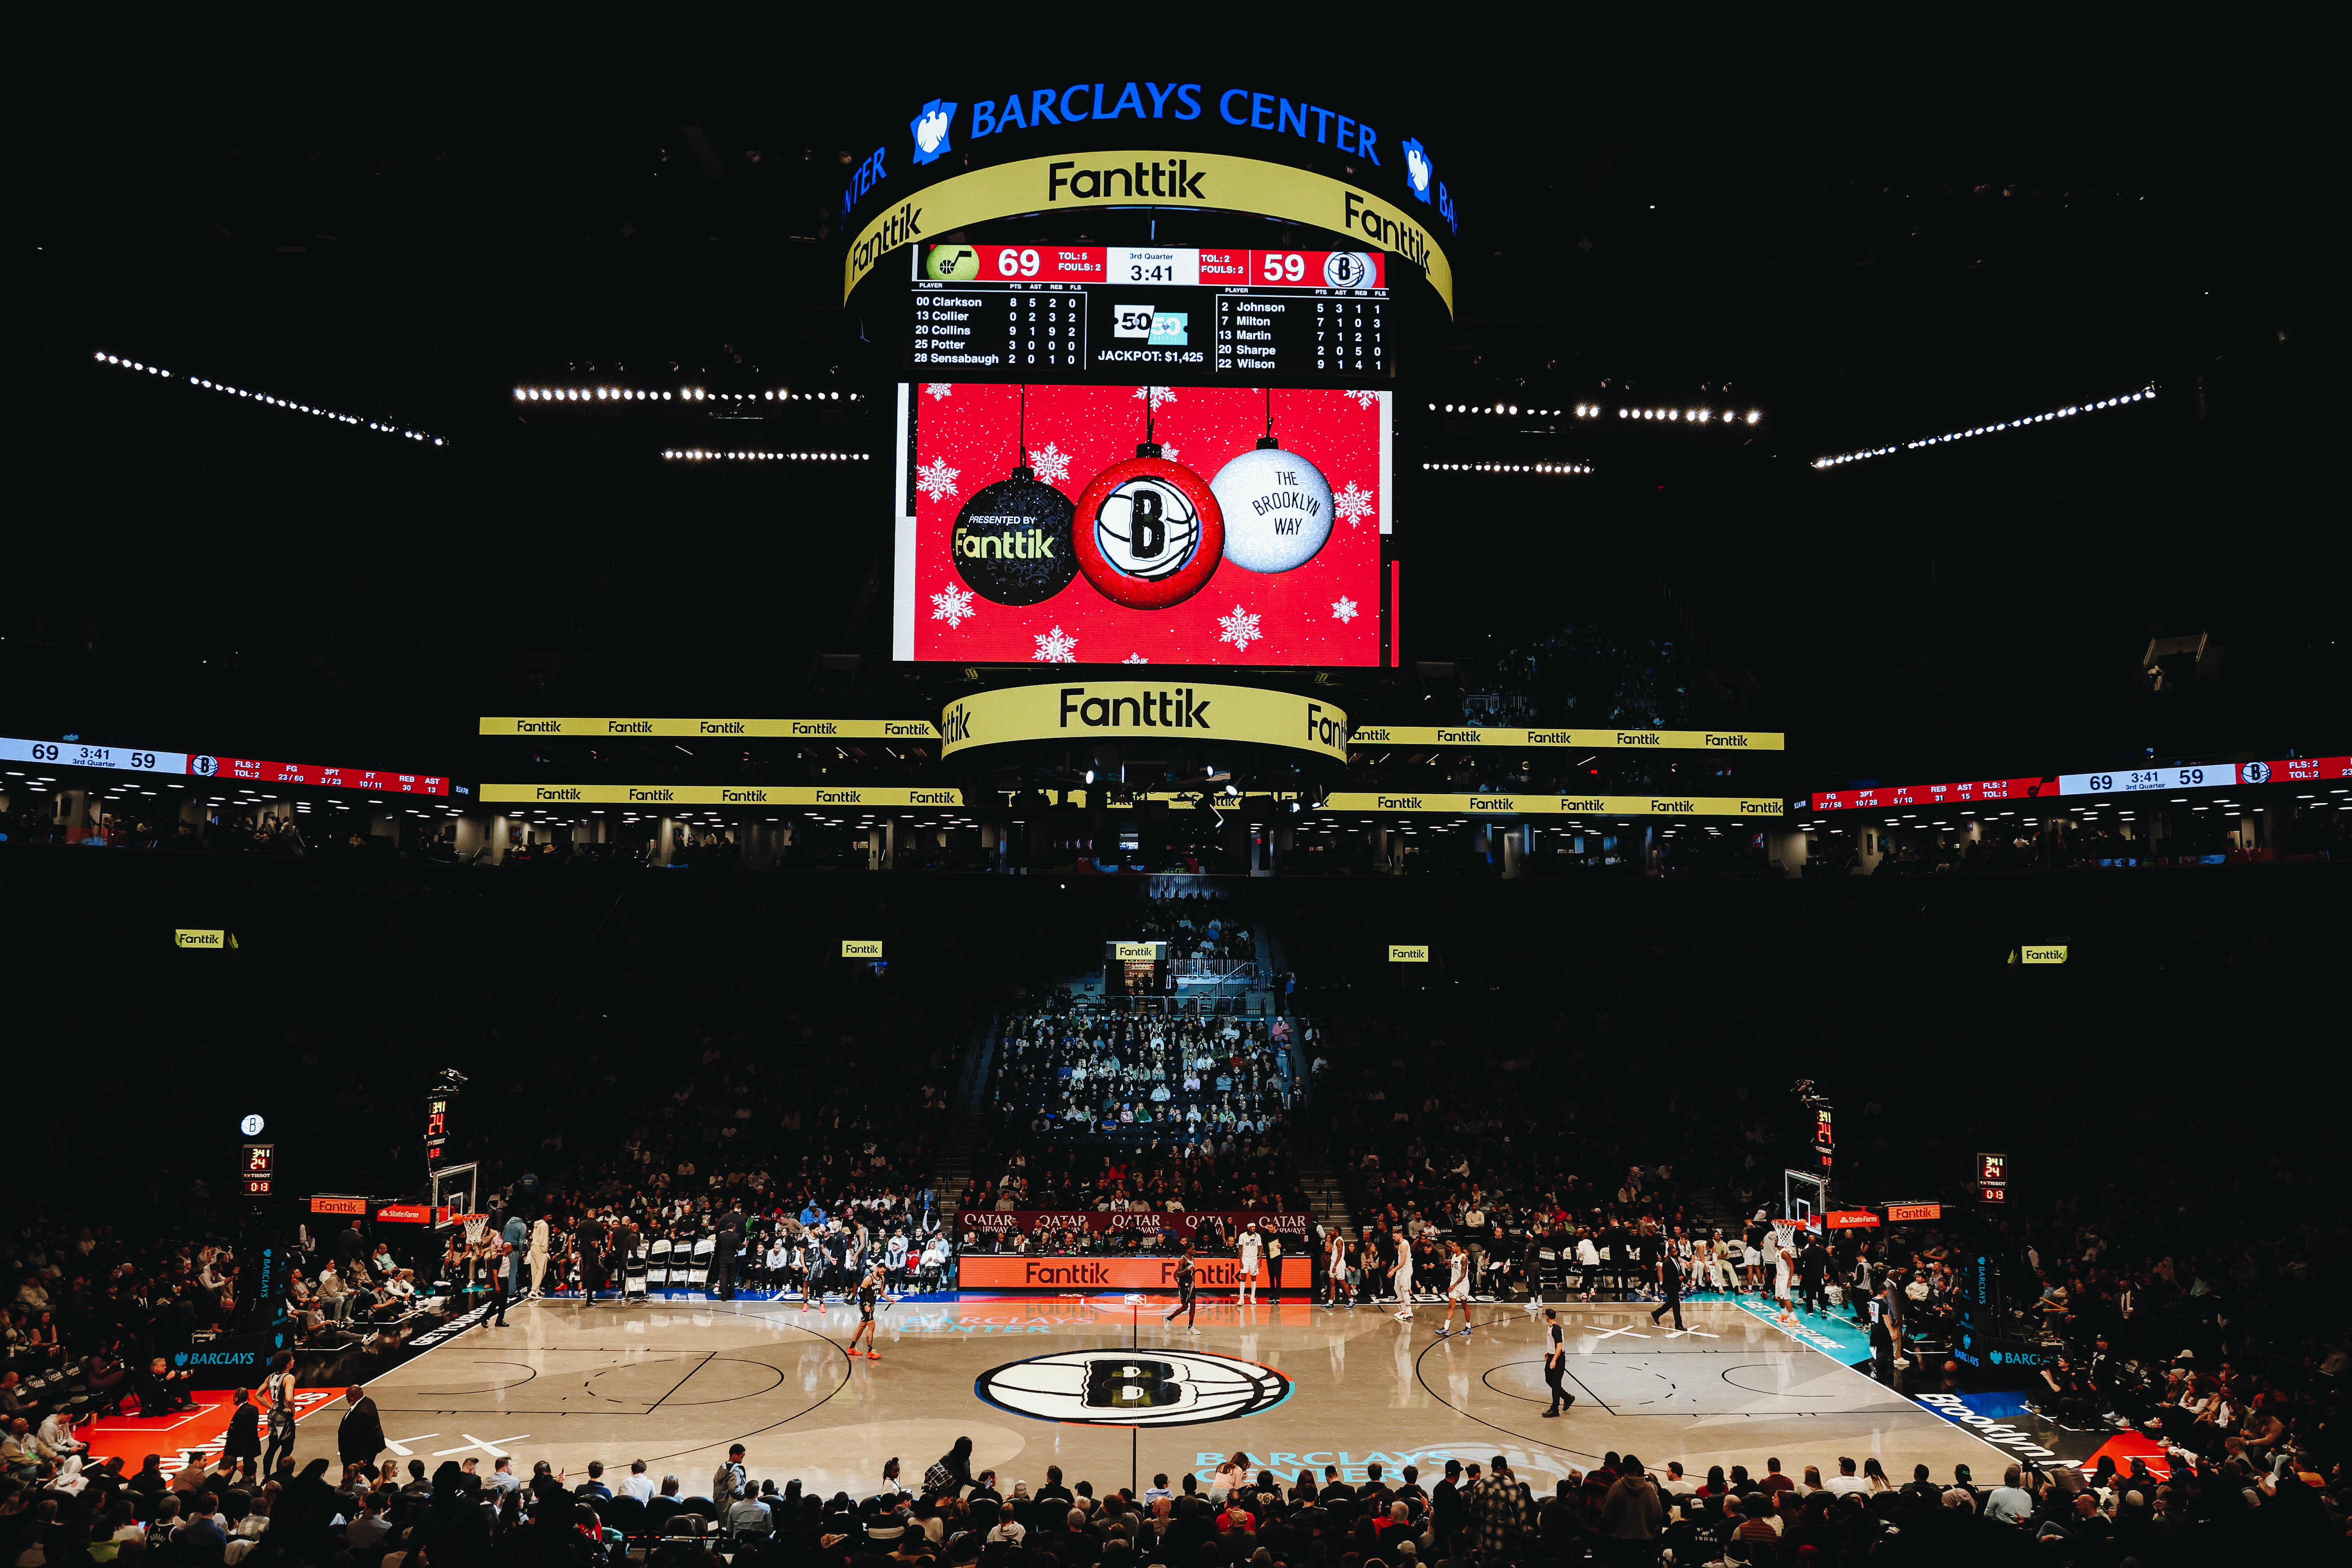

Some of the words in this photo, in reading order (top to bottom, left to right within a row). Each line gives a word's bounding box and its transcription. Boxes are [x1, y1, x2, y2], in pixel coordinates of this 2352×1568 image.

[971, 82, 1201, 139] BARCLAYS
[1220, 89, 1380, 166] CENTER
[1049, 159, 1207, 201] Fanttik
[1345, 191, 1431, 276] Fanttik
[852, 203, 922, 282] Fanttik
[1058, 252, 1081, 260] TOL:
[1082, 252, 1088, 260] 5
[1201, 254, 1224, 263] TOL:
[998, 249, 1041, 277] 69
[1058, 263, 1094, 271] FOULS:
[1263, 254, 1306, 282] 59
[1131, 265, 1172, 281] 3:41
[1201, 265, 1237, 274] FOULS:
[1238, 266, 1244, 274] 2
[916, 296, 929, 306] 00
[933, 297, 982, 307] Clarkson
[1221, 302, 1229, 311] 2
[1237, 302, 1285, 312] Johnson
[916, 311, 929, 320] 13
[932, 311, 969, 321] Collier
[1122, 313, 1152, 330] 50
[1221, 316, 1229, 325] 7
[1237, 316, 1270, 326] Milton
[915, 325, 929, 334] 20
[931, 325, 971, 335] Collins
[1150, 317, 1181, 336] 50
[1219, 330, 1232, 339] 13
[1237, 330, 1271, 340] Martin
[915, 339, 928, 348] 25
[931, 339, 965, 349] Potter
[1218, 344, 1232, 354] 20
[1236, 345, 1276, 357] Sharpe
[914, 353, 927, 362] 28
[931, 353, 999, 366] Sensabaugh
[1098, 350, 1162, 361] JACKPOT:
[1165, 351, 1203, 364] $1,425
[1218, 359, 1232, 368] 22
[1237, 359, 1275, 369] Wilson
[1275, 471, 1299, 485] THE
[1252, 492, 1321, 517] BROOKLYN
[968, 515, 1021, 524] PRESENTED
[1132, 490, 1167, 559] B
[1274, 518, 1303, 535] WAY
[955, 528, 1055, 559] Fanttik
[1060, 688, 1211, 729] Fanttik
[517, 720, 562, 732] Fanttik
[608, 721, 653, 733] Fanttik
[700, 721, 745, 733] Fanttik
[792, 722, 837, 734] Fanttik
[885, 723, 930, 735] Fanttik
[1437, 730, 1481, 742] Fanttik
[1528, 731, 1571, 744] Fanttik
[1617, 733, 1660, 745] Fanttik
[1706, 734, 1748, 746] Fanttik
[32, 744, 58, 760] 69
[80, 747, 110, 760] 3:41
[87, 759, 116, 768] Quarter
[131, 752, 155, 769] 59
[201, 757, 209, 773] B
[2131, 771, 2158, 783] 3:41
[2180, 769, 2204, 785] 59
[2251, 764, 2260, 780] B
[2090, 775, 2112, 790] 69
[537, 788, 581, 800] Fanttik
[629, 789, 674, 801] Fanttik
[722, 789, 767, 802] Fanttik
[816, 790, 861, 802] Fanttik
[910, 791, 955, 804] Fanttik
[1378, 796, 1423, 809] Fanttik
[1470, 798, 1514, 810] Fanttik
[1561, 799, 1604, 811] Fanttik
[1651, 800, 1694, 812] Fanttik
[1740, 801, 1783, 813] Fanttik
[180, 934, 220, 944] Fanttik
[846, 944, 878, 953] Fanttik
[1120, 947, 1152, 956] Fanttik
[1393, 949, 1425, 958] Fanttik
[2026, 950, 2063, 960] Fanttik
[249, 1118, 256, 1132] B
[429, 1114, 445, 1135] 24
[1818, 1123, 1831, 1143] 24
[251, 1158, 265, 1169] 24
[1985, 1166, 2000, 1178] 24
[251, 1182, 269, 1192] 0:13
[1987, 1190, 2004, 1200] 0:13
[319, 1201, 356, 1212] Fanttik
[1896, 1208, 1932, 1219] Fanttik
[964, 1214, 1012, 1226] QATAR
[261, 1259, 270, 1298] BARCLAYS
[1026, 1262, 1109, 1284] Fanttik
[906, 1316, 1094, 1325] BARCLAYS
[899, 1325, 1052, 1333] CENTER
[190, 1352, 254, 1365] BARCLAYS
[1955, 1348, 1979, 1367] BARCLAYS
